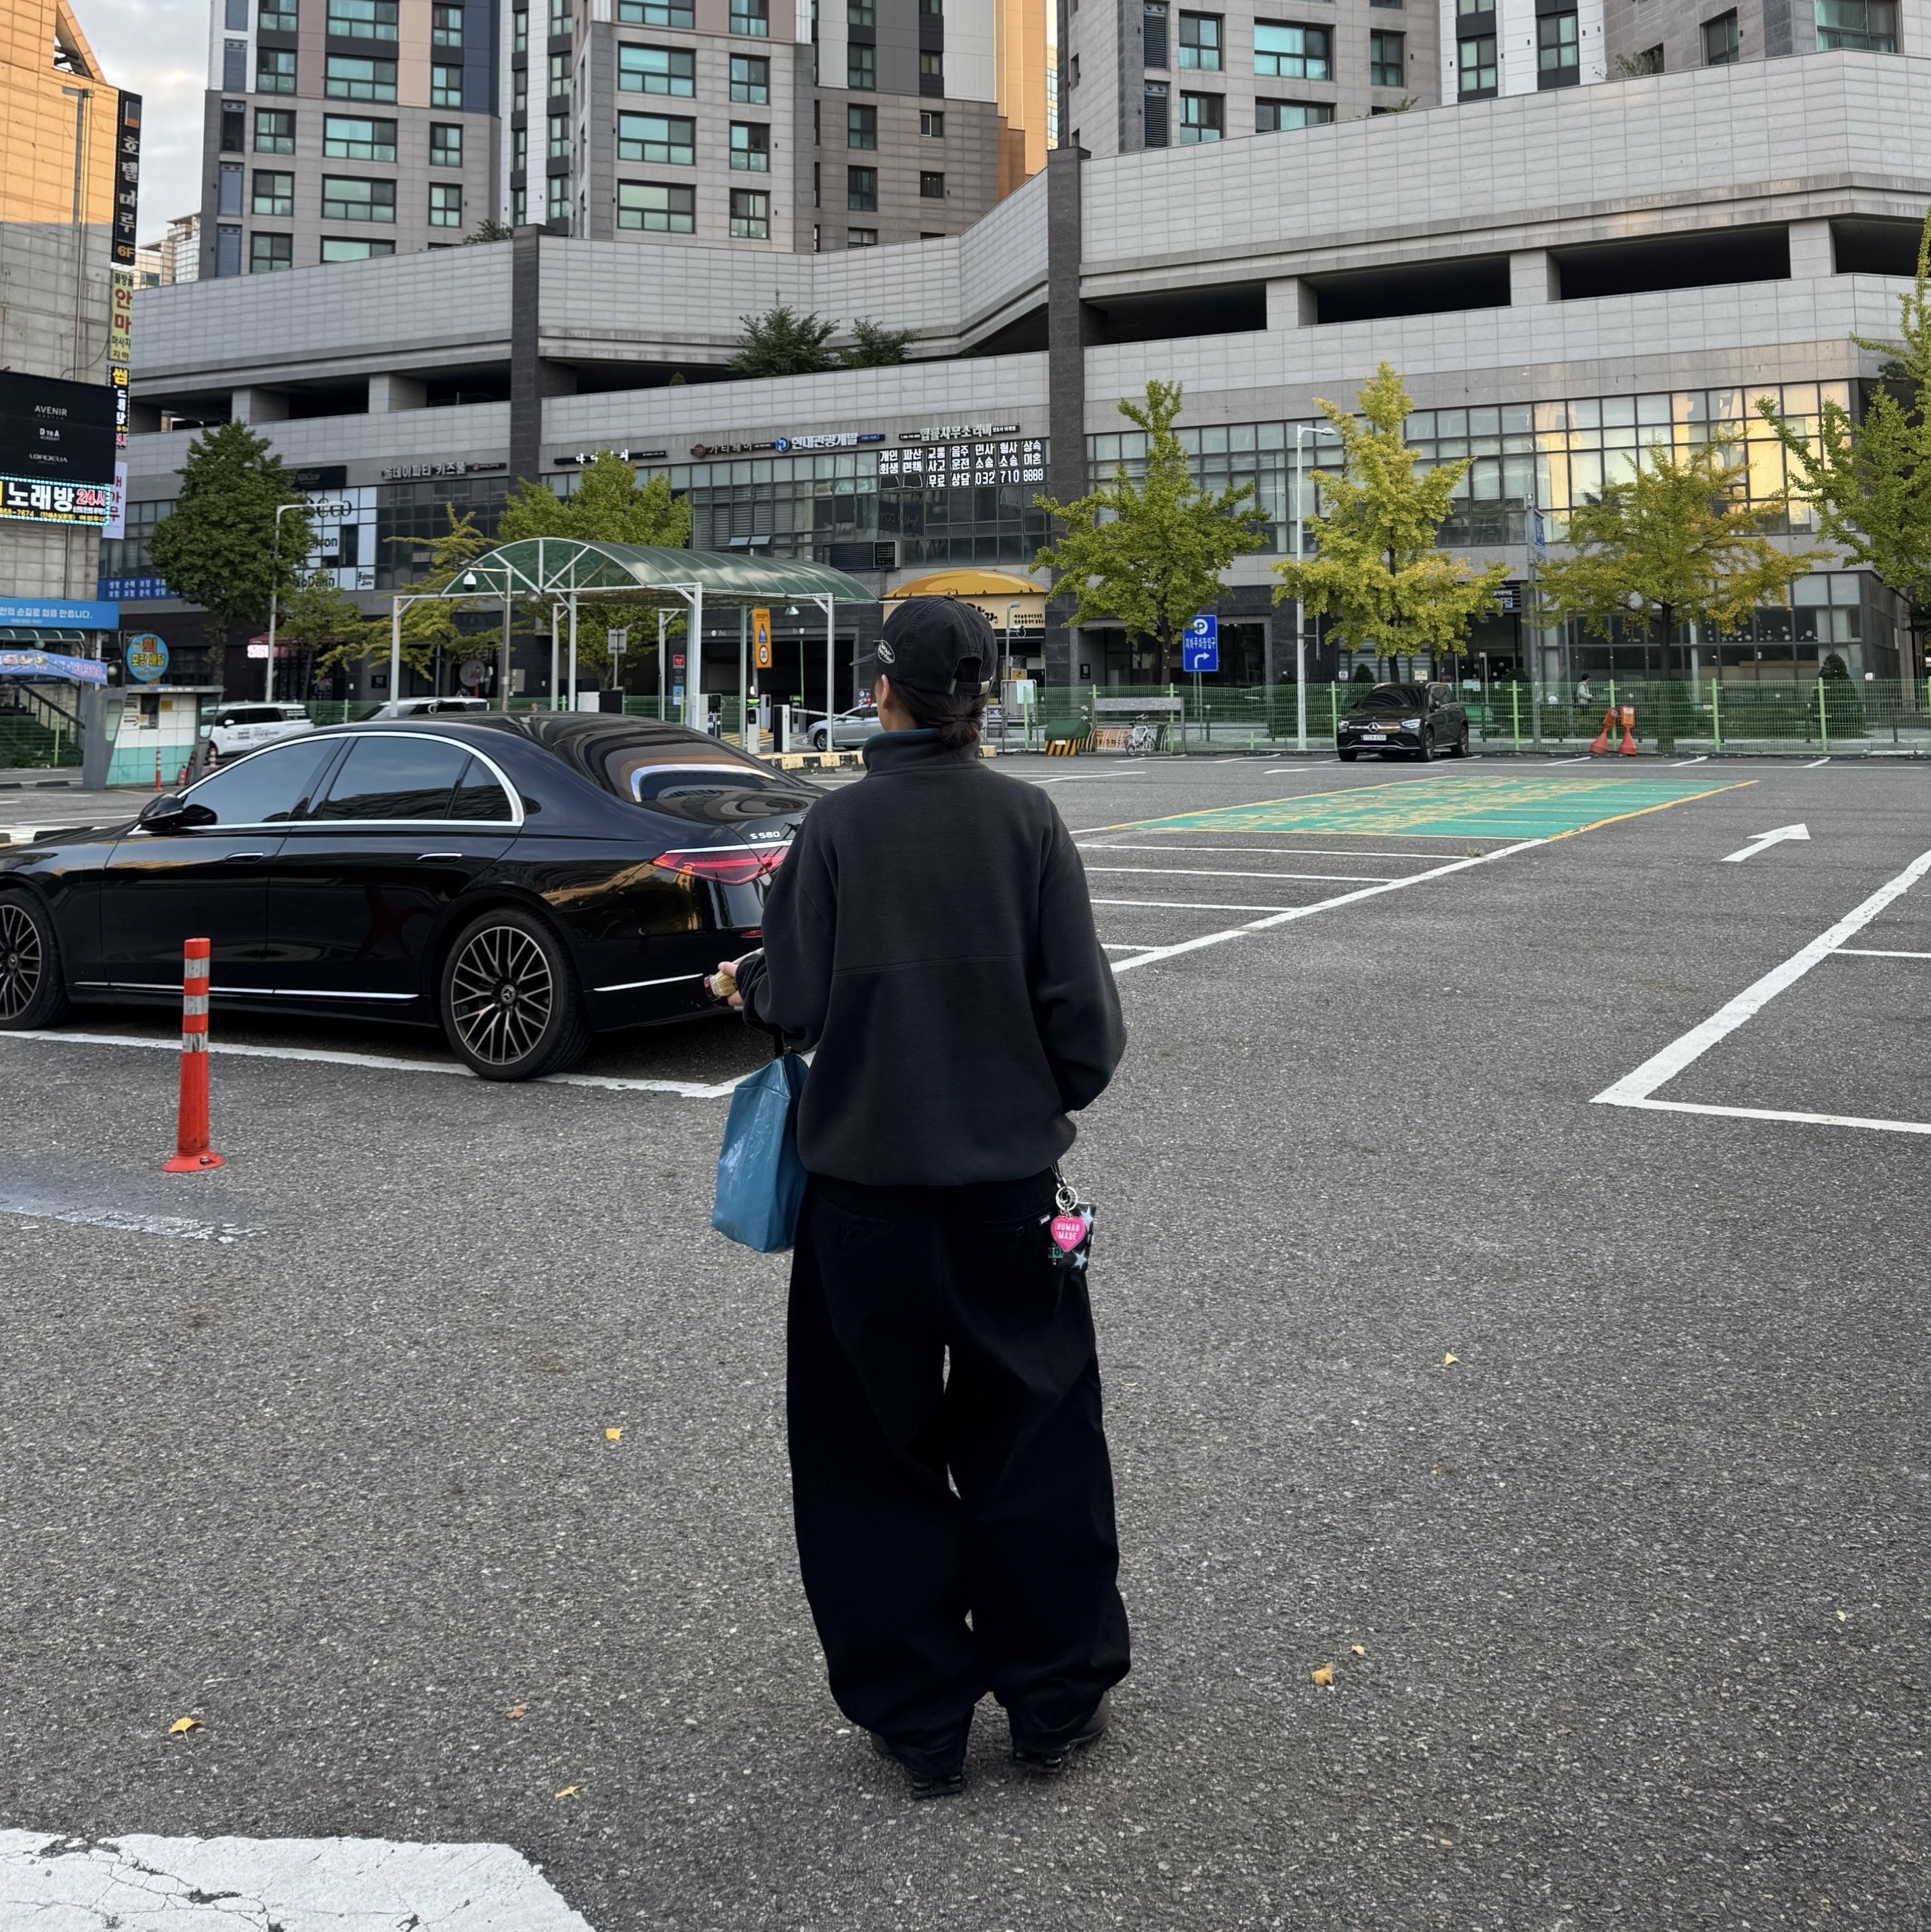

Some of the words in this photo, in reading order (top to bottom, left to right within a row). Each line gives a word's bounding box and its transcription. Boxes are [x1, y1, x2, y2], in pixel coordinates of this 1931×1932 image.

[119, 135, 139, 233] 호텔마루
[117, 245, 135, 258] 6F
[115, 288, 133, 335] 안마
[112, 335, 131, 349] 마사지
[35, 405, 67, 416] AVENIR
[40, 427, 45, 435] D
[54, 429, 60, 437] A
[791, 433, 858, 450] 현대관광개발
[880, 450, 898, 461] 개인
[903, 448, 922, 460] 파산
[928, 447, 946, 459] 교통
[952, 445, 969, 458] 음주
[975, 443, 994, 456] 민사
[1000, 442, 1018, 454] 형사
[1023, 440, 1041, 452] 상속
[383, 464, 431, 479] 올데이파티
[436, 462, 466, 475] 키즈풀
[880, 462, 898, 474] 회생
[903, 460, 922, 473] 면책
[928, 460, 946, 471] 사고
[952, 458, 969, 471] 운전
[975, 456, 994, 469] 소송
[1000, 454, 1018, 467] 소송
[1023, 453, 1042, 465] 이혼
[929, 474, 945, 488] 무료
[952, 472, 971, 486] 상담
[975, 471, 995, 485] 032
[1000, 469, 1019, 484] 710
[1023, 469, 1043, 482] 8888
[7, 482, 75, 512] 노래방
[1185, 637, 1215, 649] 지하주차장입구
[759, 831, 781, 839] 580
[1057, 1222, 1080, 1232] HUMAN
[1059, 1232, 1077, 1241] MADE
